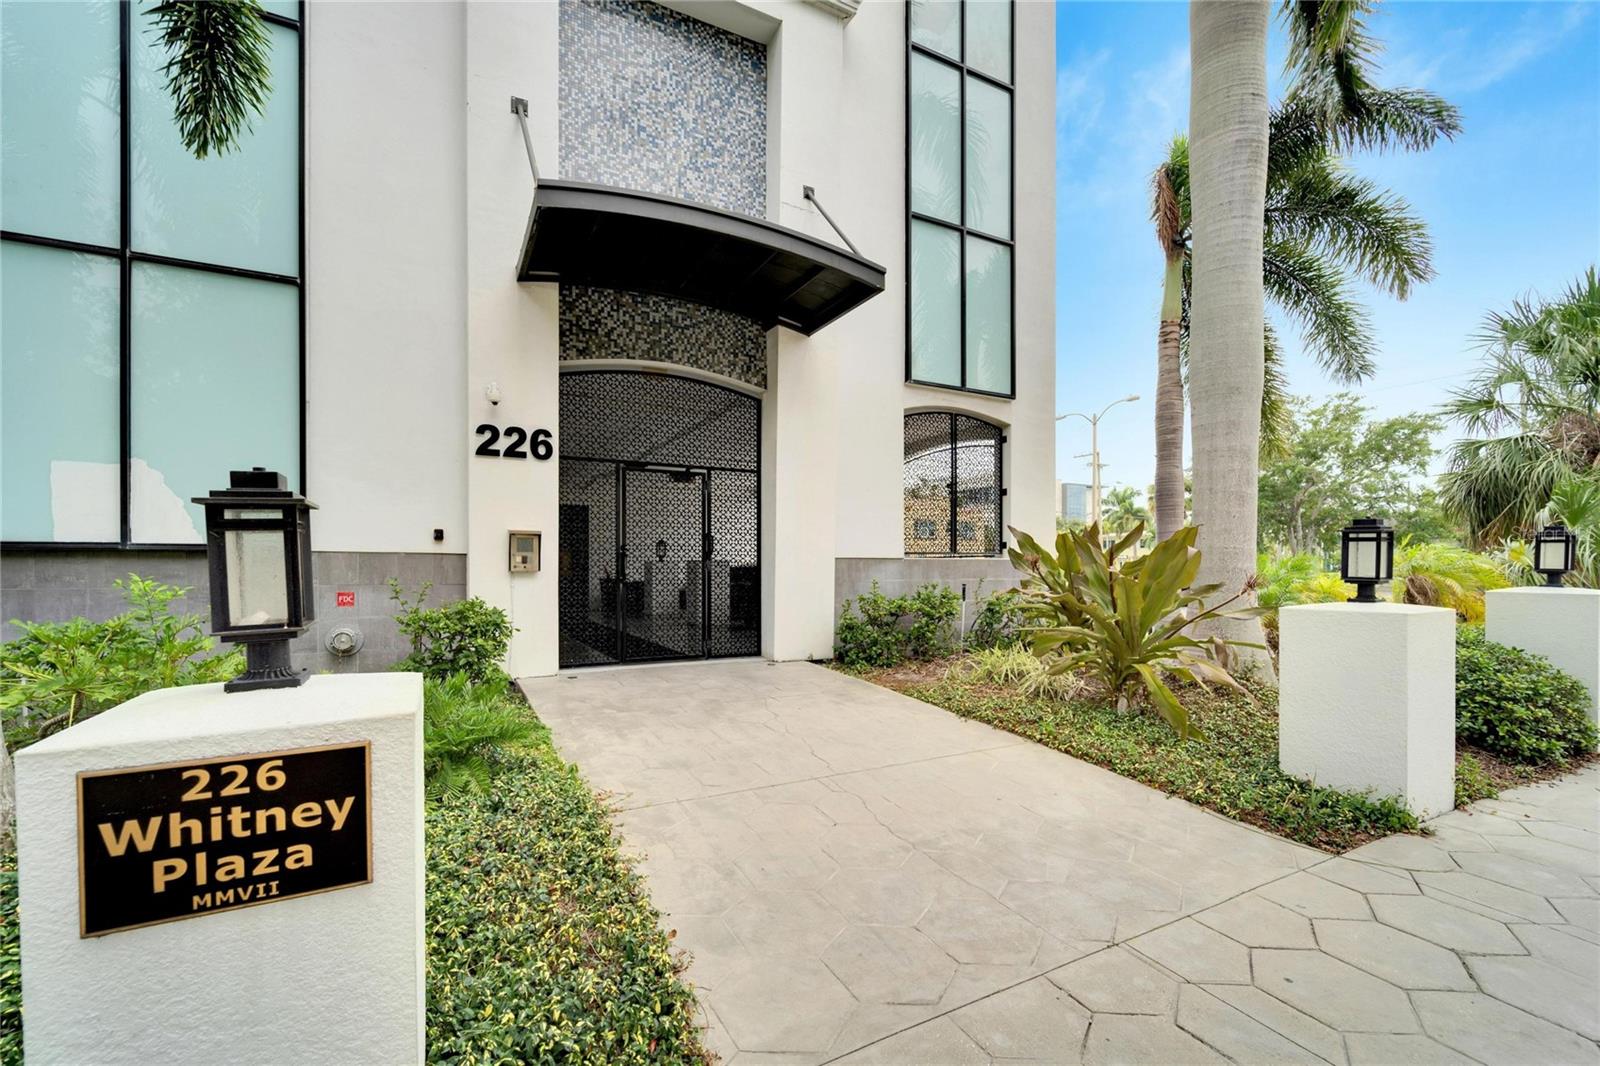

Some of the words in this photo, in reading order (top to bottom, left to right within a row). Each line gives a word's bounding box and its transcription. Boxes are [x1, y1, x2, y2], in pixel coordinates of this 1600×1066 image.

[475, 423, 553, 460] 226
[338, 595, 354, 603] FDC
[180, 760, 287, 802] 226
[98, 796, 356, 858] Whitney
[153, 843, 314, 893] Plaza
[192, 881, 280, 911] MMVII
